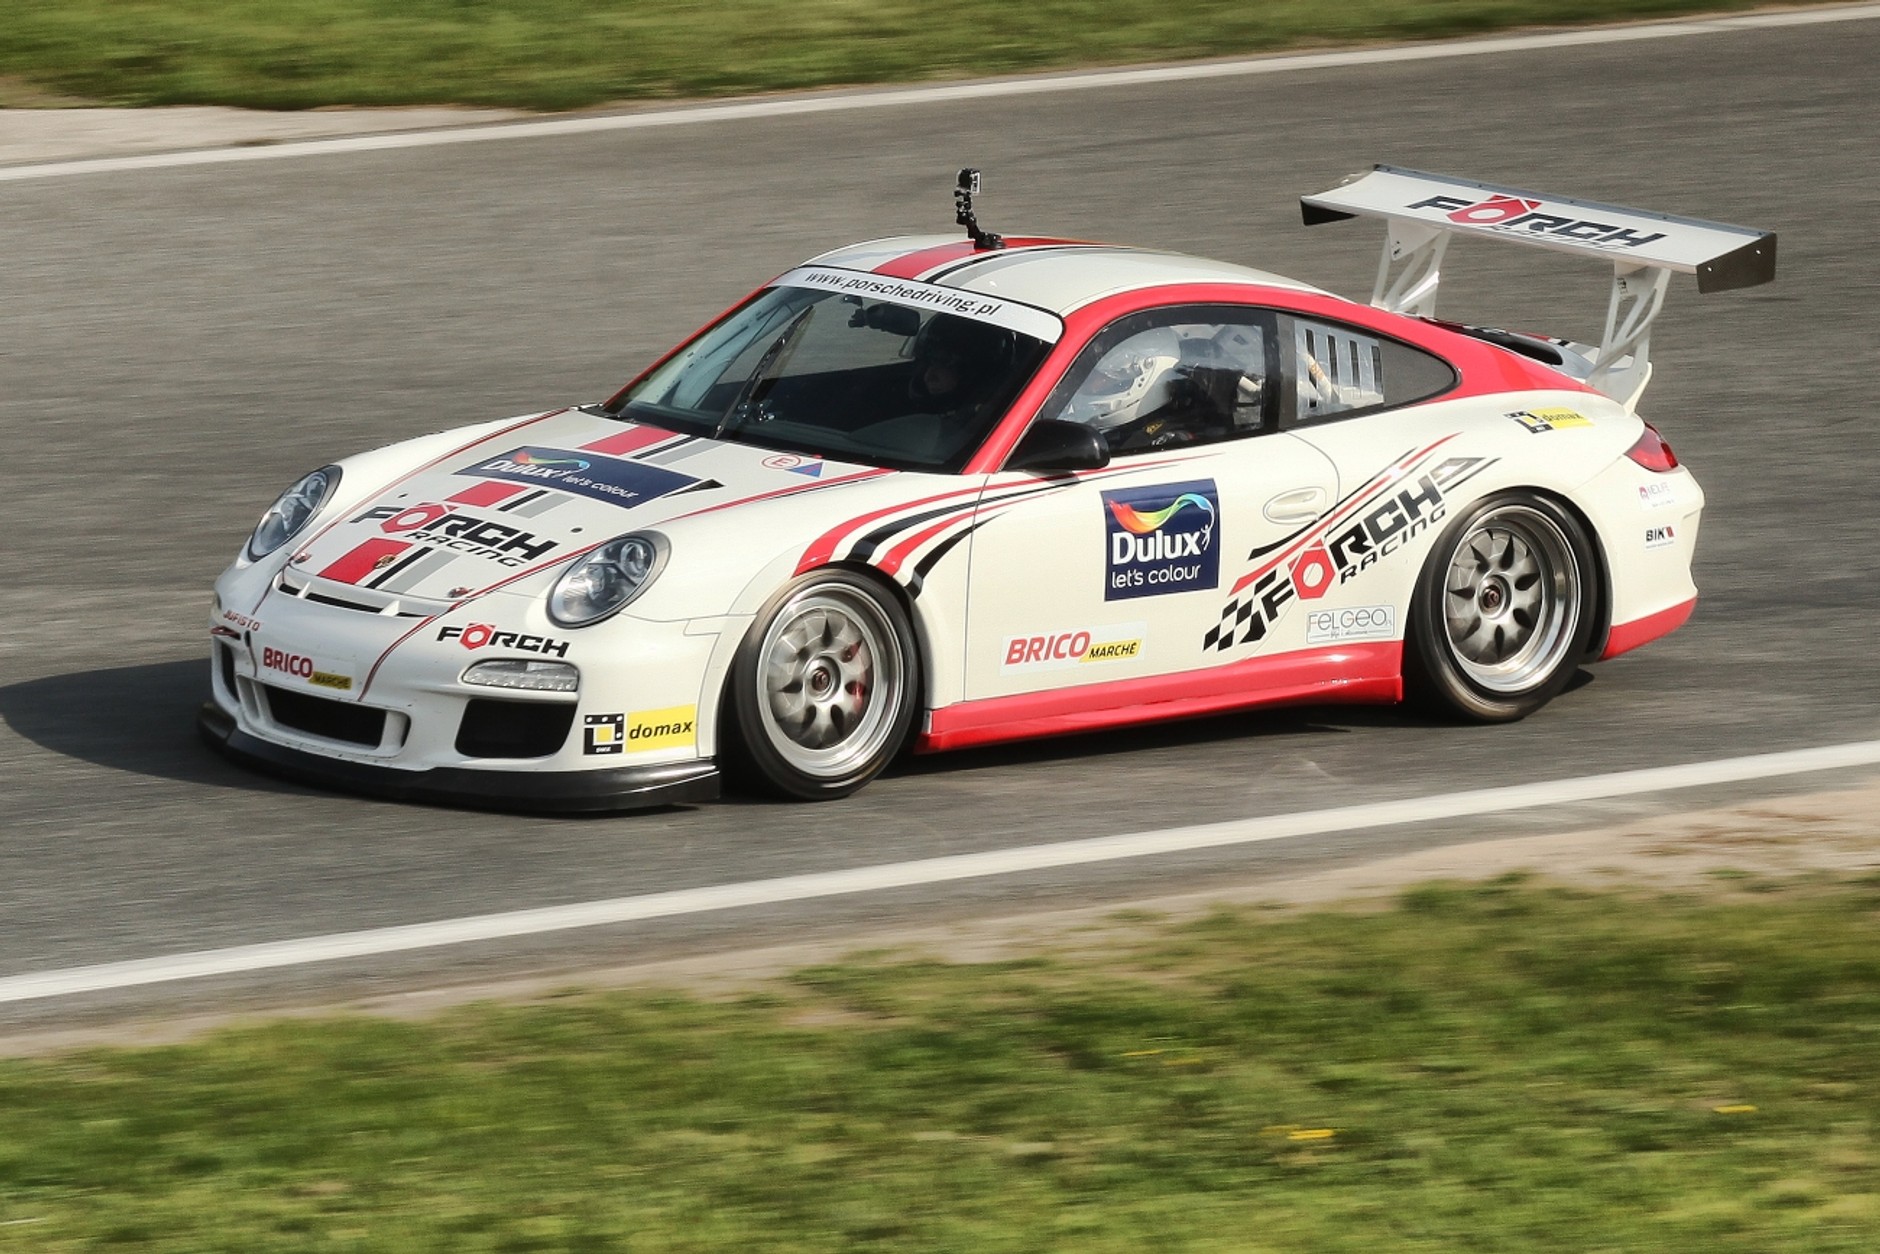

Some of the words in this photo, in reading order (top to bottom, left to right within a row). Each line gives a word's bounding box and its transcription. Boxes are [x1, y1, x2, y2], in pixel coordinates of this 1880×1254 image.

[805, 273, 1003, 316] www.porschedriving.pl
[481, 459, 558, 479] Dulux
[591, 481, 639, 499] colour
[404, 531, 527, 567] RACING
[1112, 530, 1201, 565] Dulux
[1340, 503, 1446, 585] RACING
[1112, 569, 1144, 588] let's
[1148, 564, 1201, 584] colour
[263, 647, 313, 678] BRICO
[1005, 631, 1090, 665] BRICO
[629, 721, 693, 740] domax
